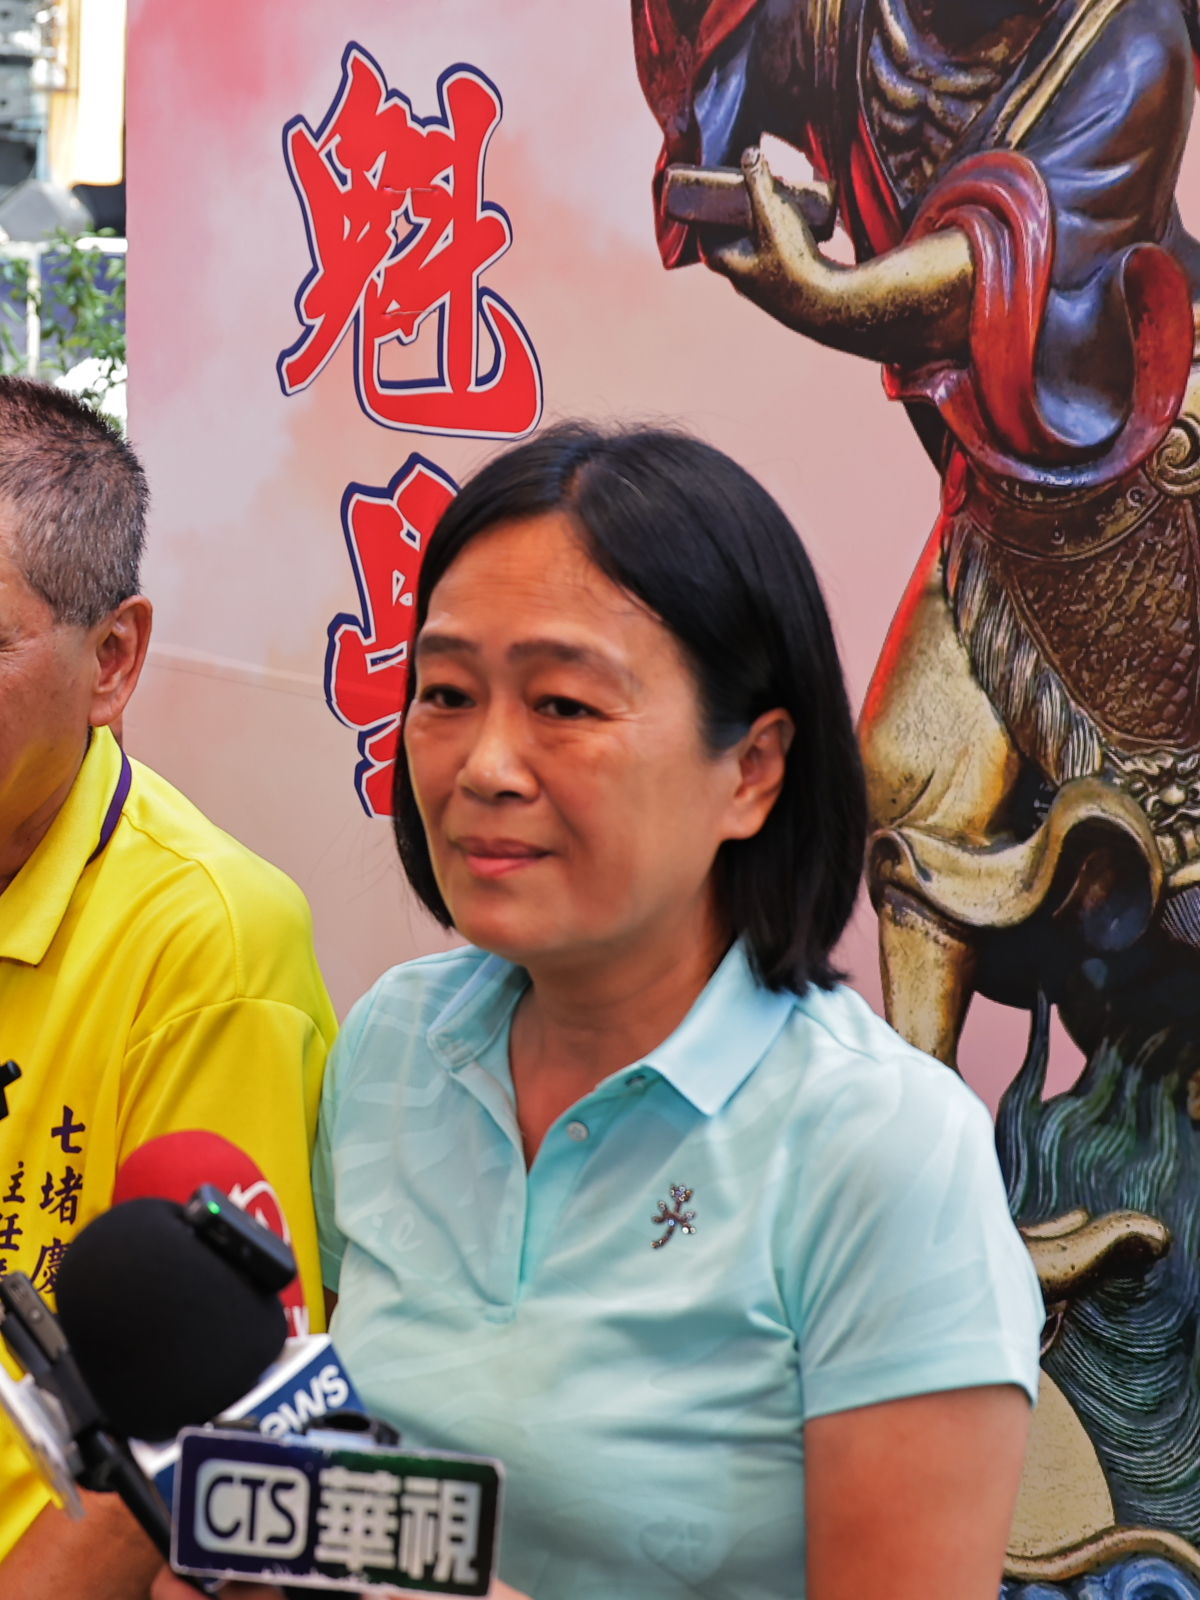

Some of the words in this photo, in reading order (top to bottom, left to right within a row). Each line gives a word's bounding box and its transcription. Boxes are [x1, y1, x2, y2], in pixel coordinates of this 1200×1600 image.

[259, 1363, 350, 1438] ews
[204, 1474, 297, 1544] CTS
[313, 1465, 482, 1585] 華視
